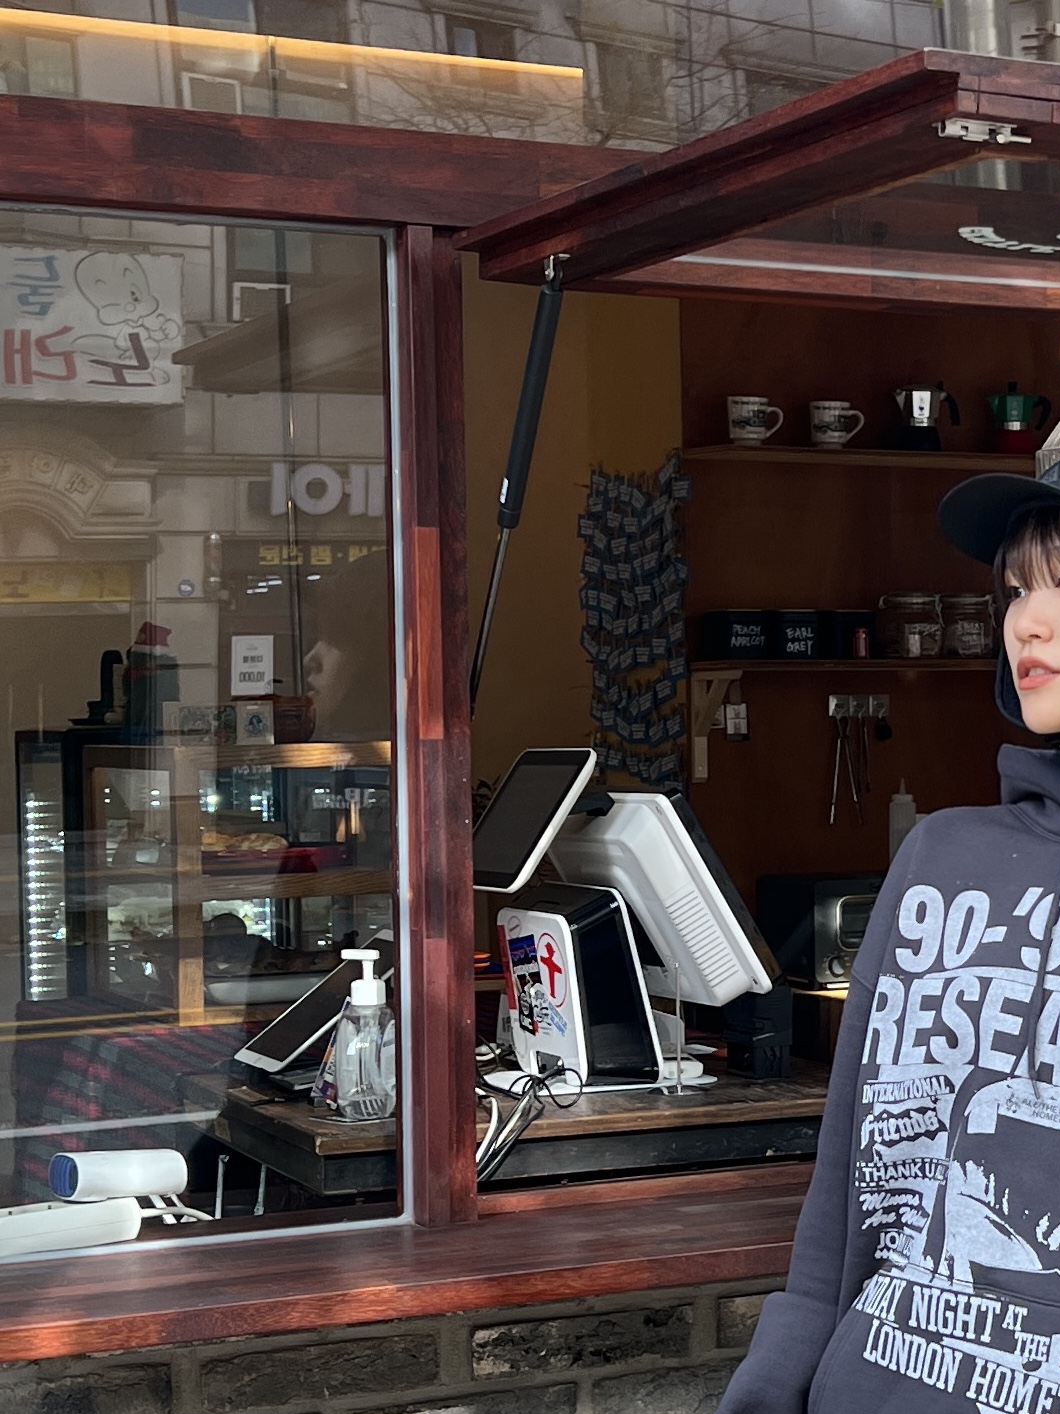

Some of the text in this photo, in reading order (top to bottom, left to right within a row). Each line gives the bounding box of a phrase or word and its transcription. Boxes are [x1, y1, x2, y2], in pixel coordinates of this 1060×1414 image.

[785, 626, 815, 638] EARL
[785, 641, 814, 656] GREY
[861, 1076, 949, 1104] INTERNATIONAL
[862, 1162, 923, 1184] THANK
[908, 1284, 1000, 1343] NIGHT
[1002, 1303, 1028, 1332] AT
[863, 1318, 963, 1393] LONDON
[1013, 1331, 1051, 1362] THE
